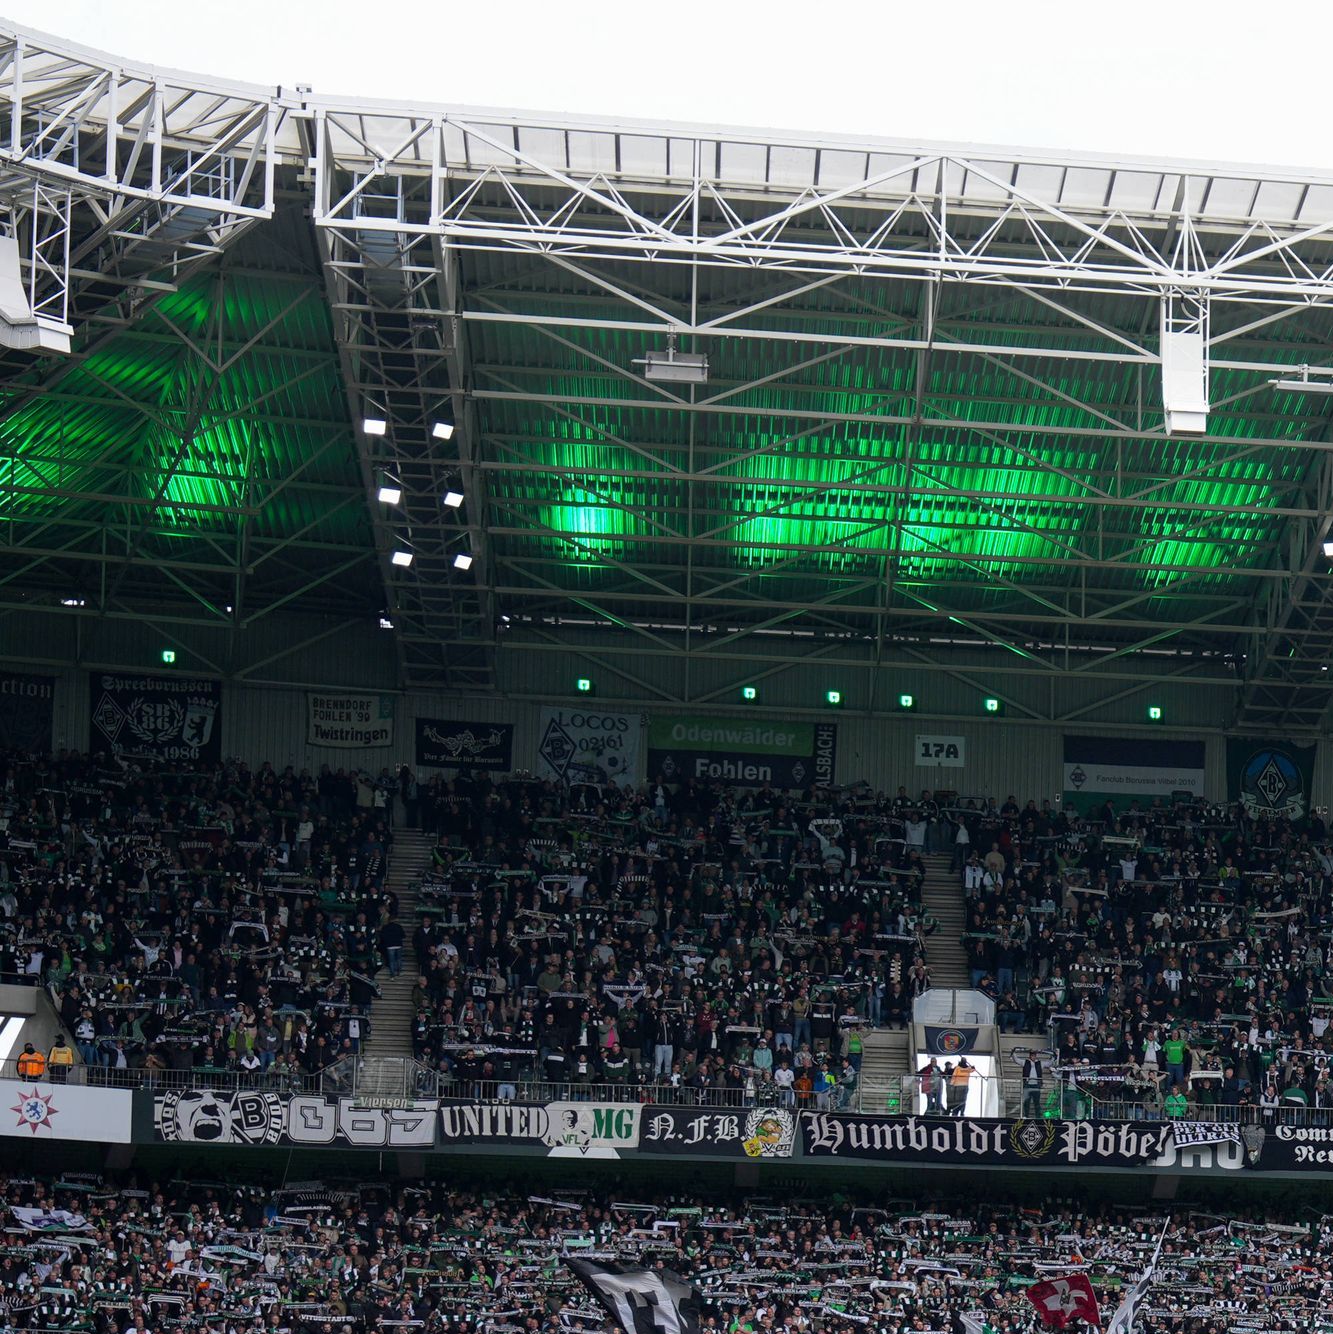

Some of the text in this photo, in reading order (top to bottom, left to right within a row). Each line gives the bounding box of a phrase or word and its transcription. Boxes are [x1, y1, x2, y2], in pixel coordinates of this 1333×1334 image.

[313, 698, 371, 711] BRENNDORF
[313, 710, 351, 723] FOHLEN
[557, 711, 630, 732] LOCOS
[313, 724, 389, 744] Twistringen
[671, 726, 796, 748] Odenwälder
[921, 743, 960, 759] 17A
[695, 758, 773, 783] Fohlen
[360, 1096, 408, 1108] Viersen
[440, 1105, 550, 1140] UNITED
[591, 1107, 634, 1140] MG
[803, 1110, 1007, 1155] Humboldt
[1060, 1115, 1170, 1162] Pöbel
[1175, 1132, 1240, 1144] ULTRAS
